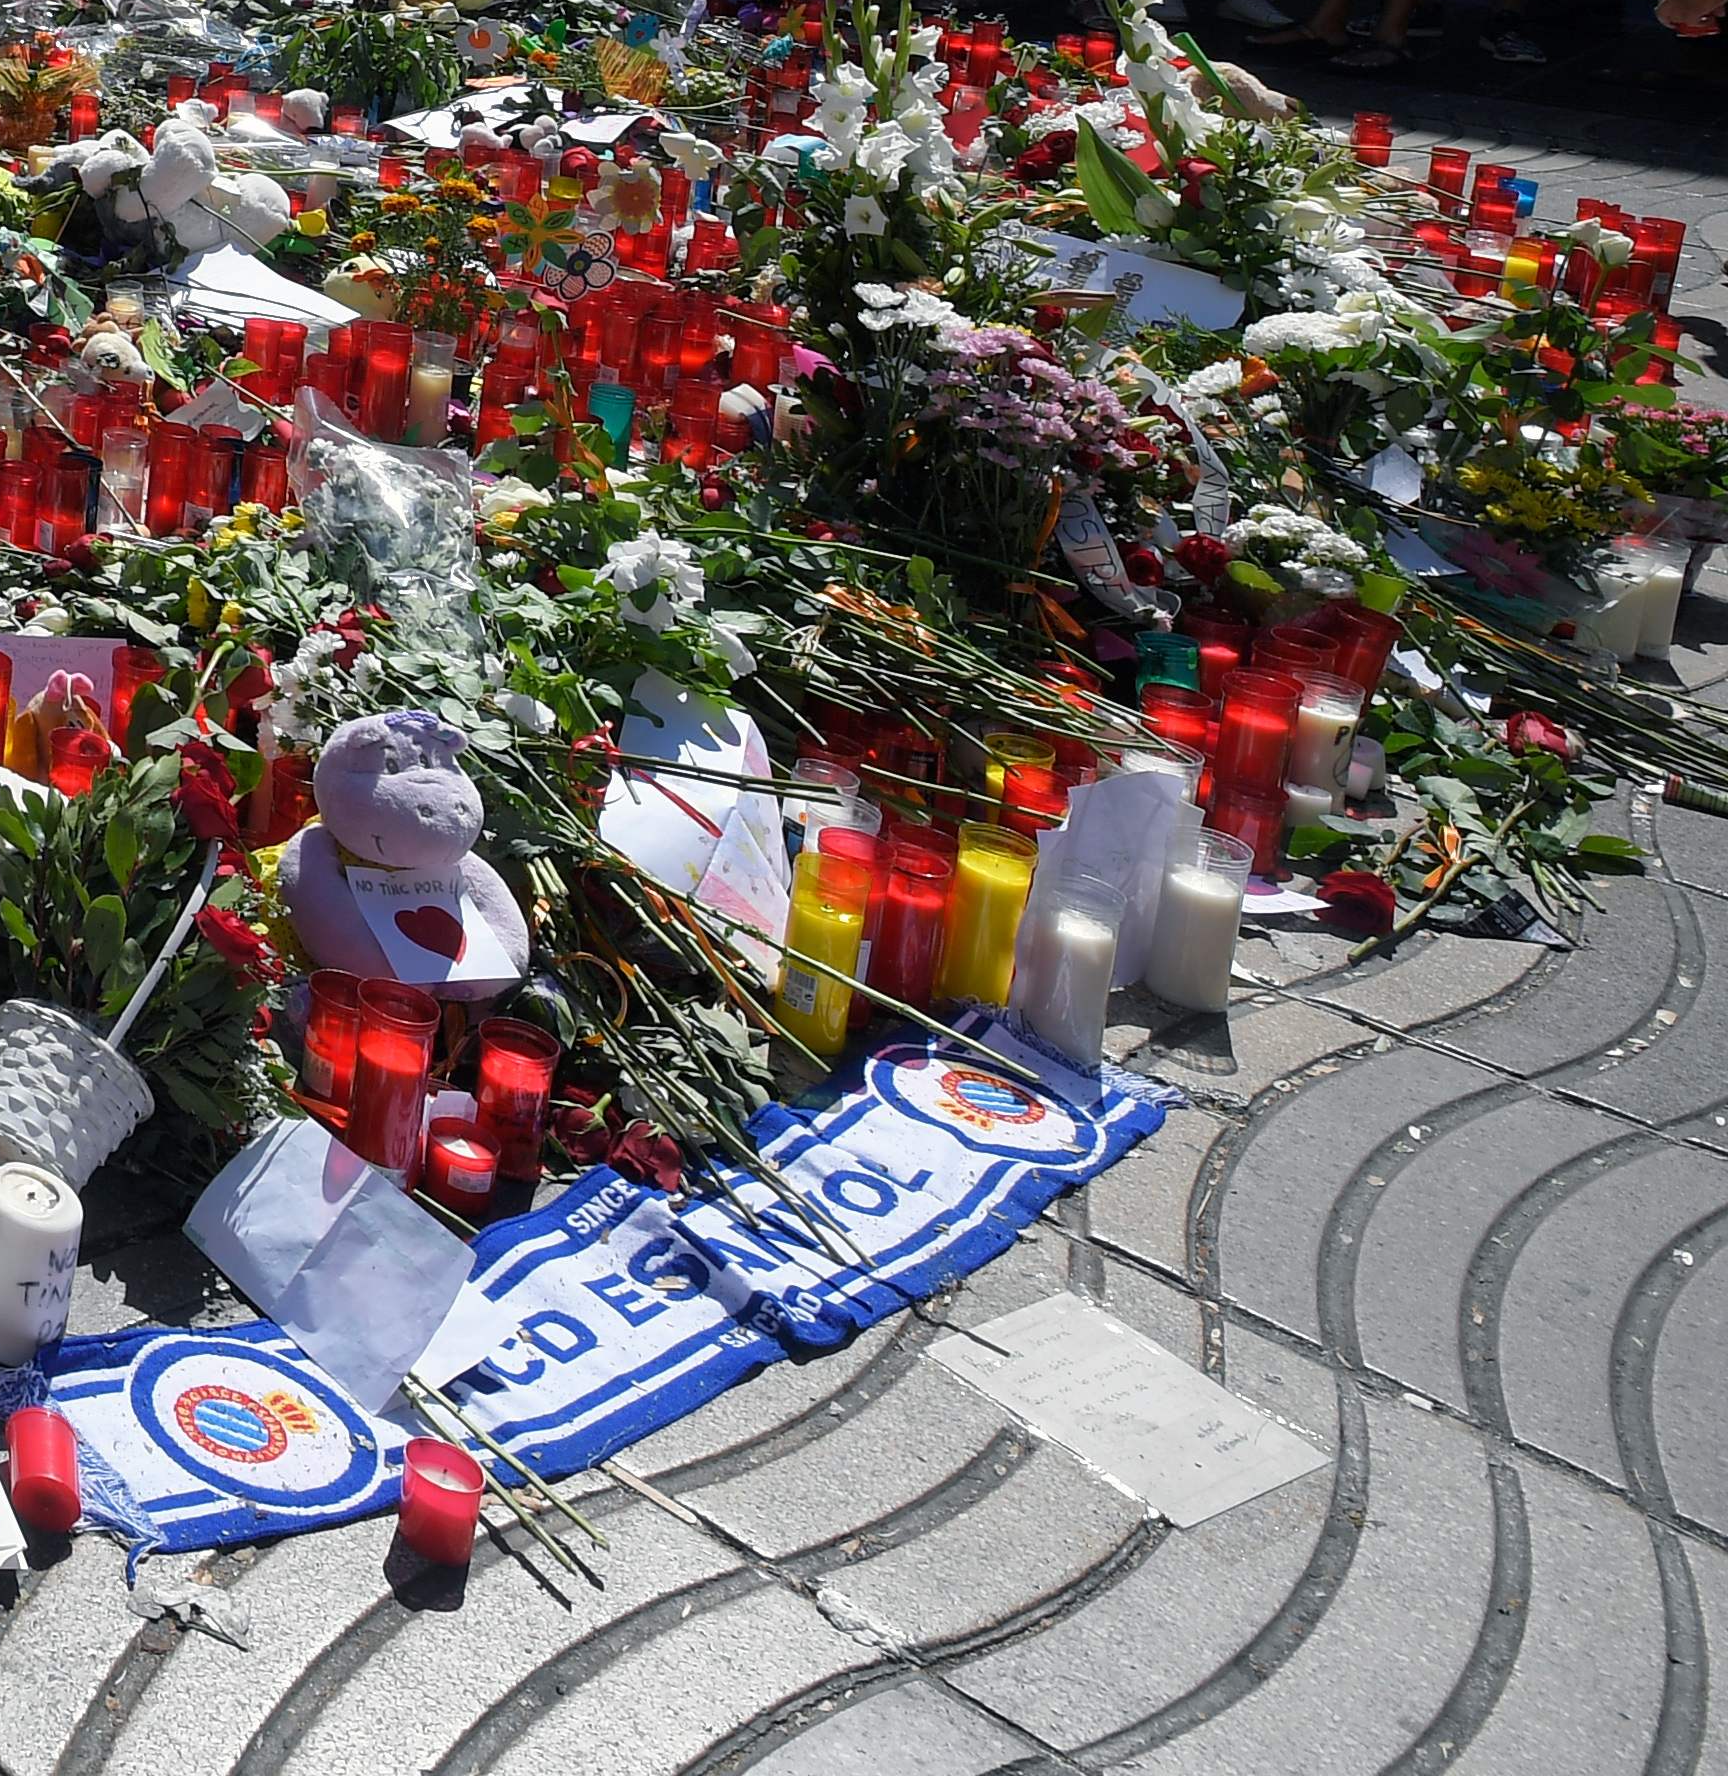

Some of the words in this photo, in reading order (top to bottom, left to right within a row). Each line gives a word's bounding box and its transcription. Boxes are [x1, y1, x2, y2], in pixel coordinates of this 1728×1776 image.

[354, 879, 374, 893] NO
[415, 879, 445, 897] POR
[566, 1177, 641, 1236] SINCE
[49, 1248, 79, 1274] NO
[442, 1305, 601, 1396] CD
[581, 1154, 934, 1330] ESANYOL
